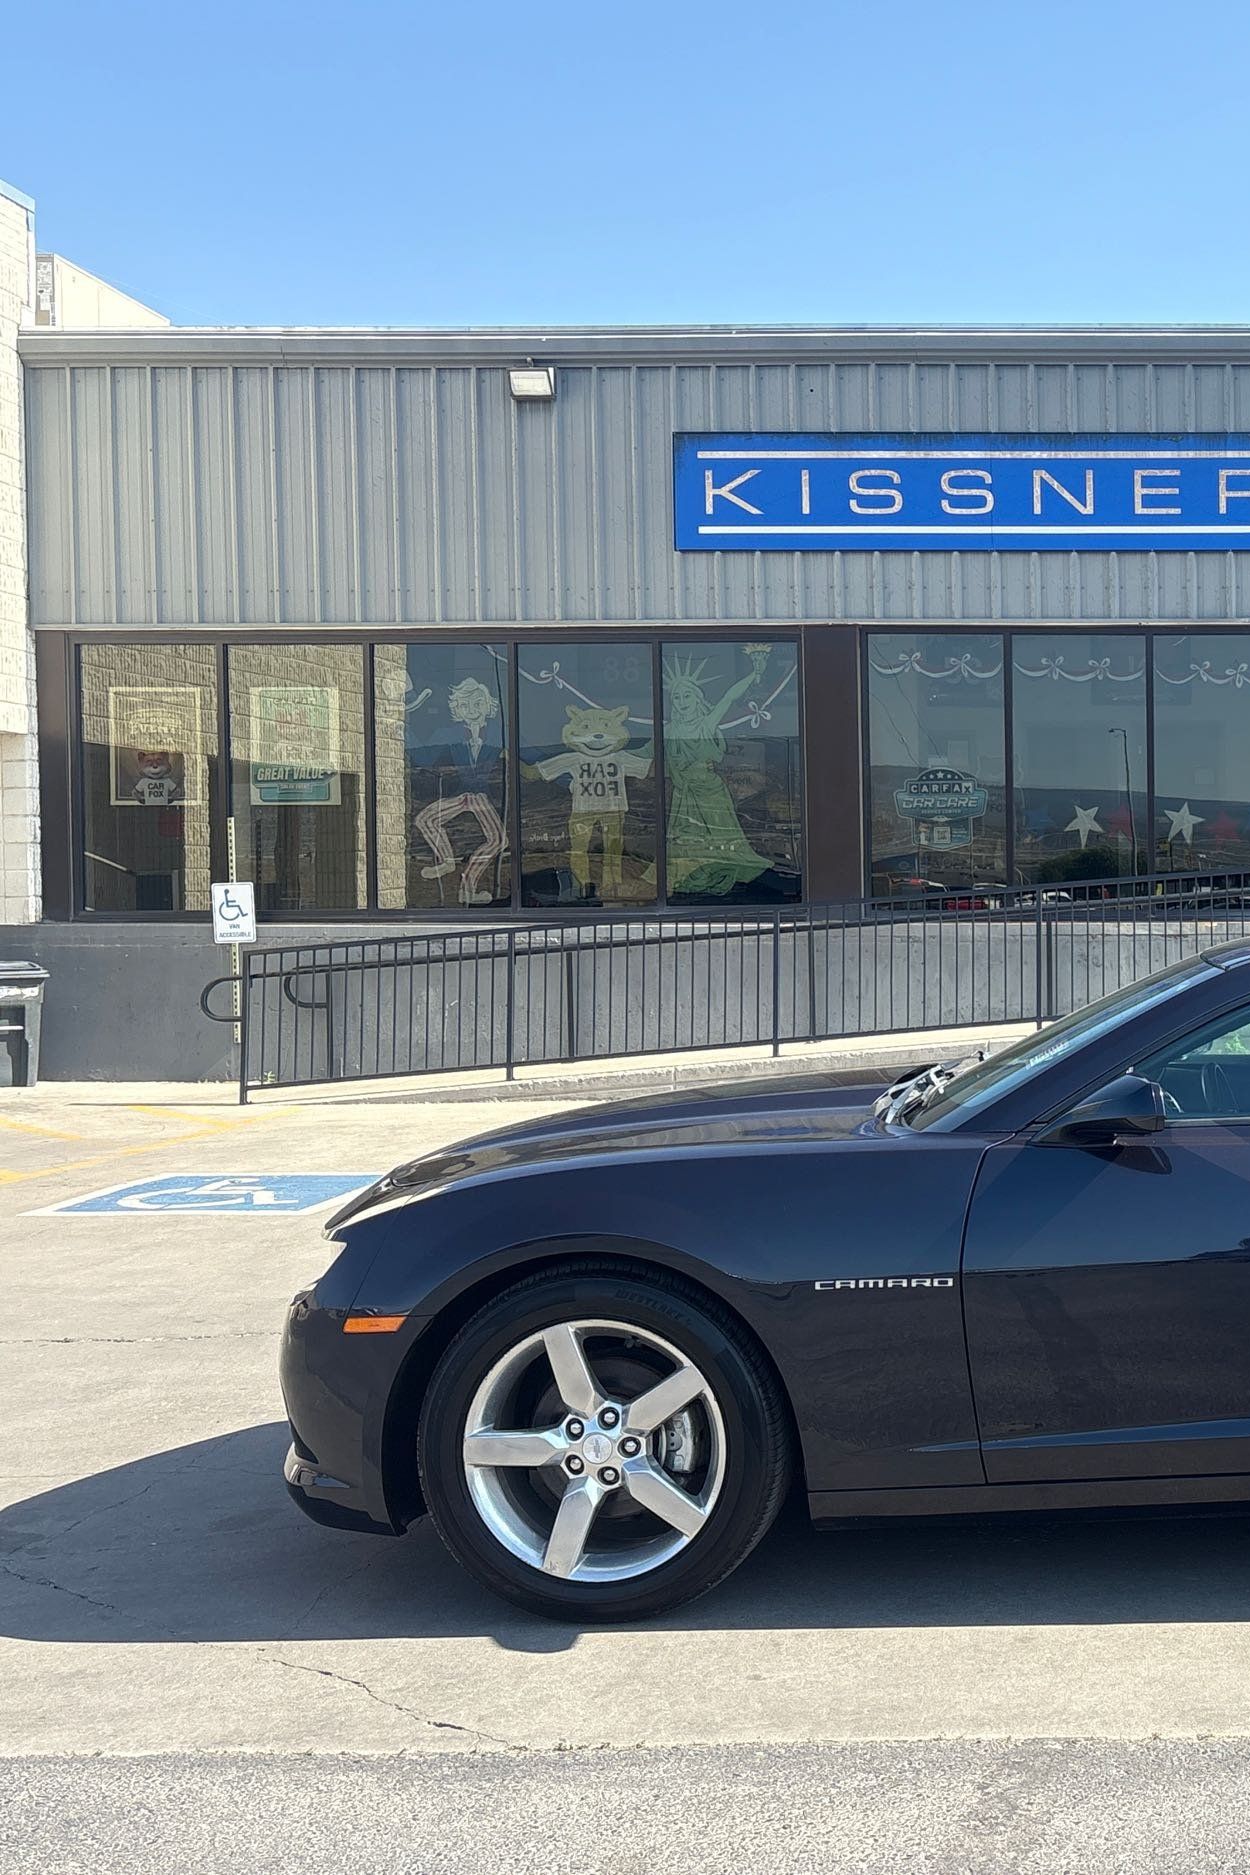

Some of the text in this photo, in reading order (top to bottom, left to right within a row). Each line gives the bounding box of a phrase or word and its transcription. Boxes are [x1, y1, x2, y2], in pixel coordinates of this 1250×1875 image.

[257, 766, 325, 781] GREAT VALUE
[147, 782, 165, 791] CAR
[910, 783, 972, 794] CARFAX
[148, 790, 165, 798] FOX
[902, 796, 979, 809] CAR CARE
[814, 1277, 954, 1291] CAMARO
